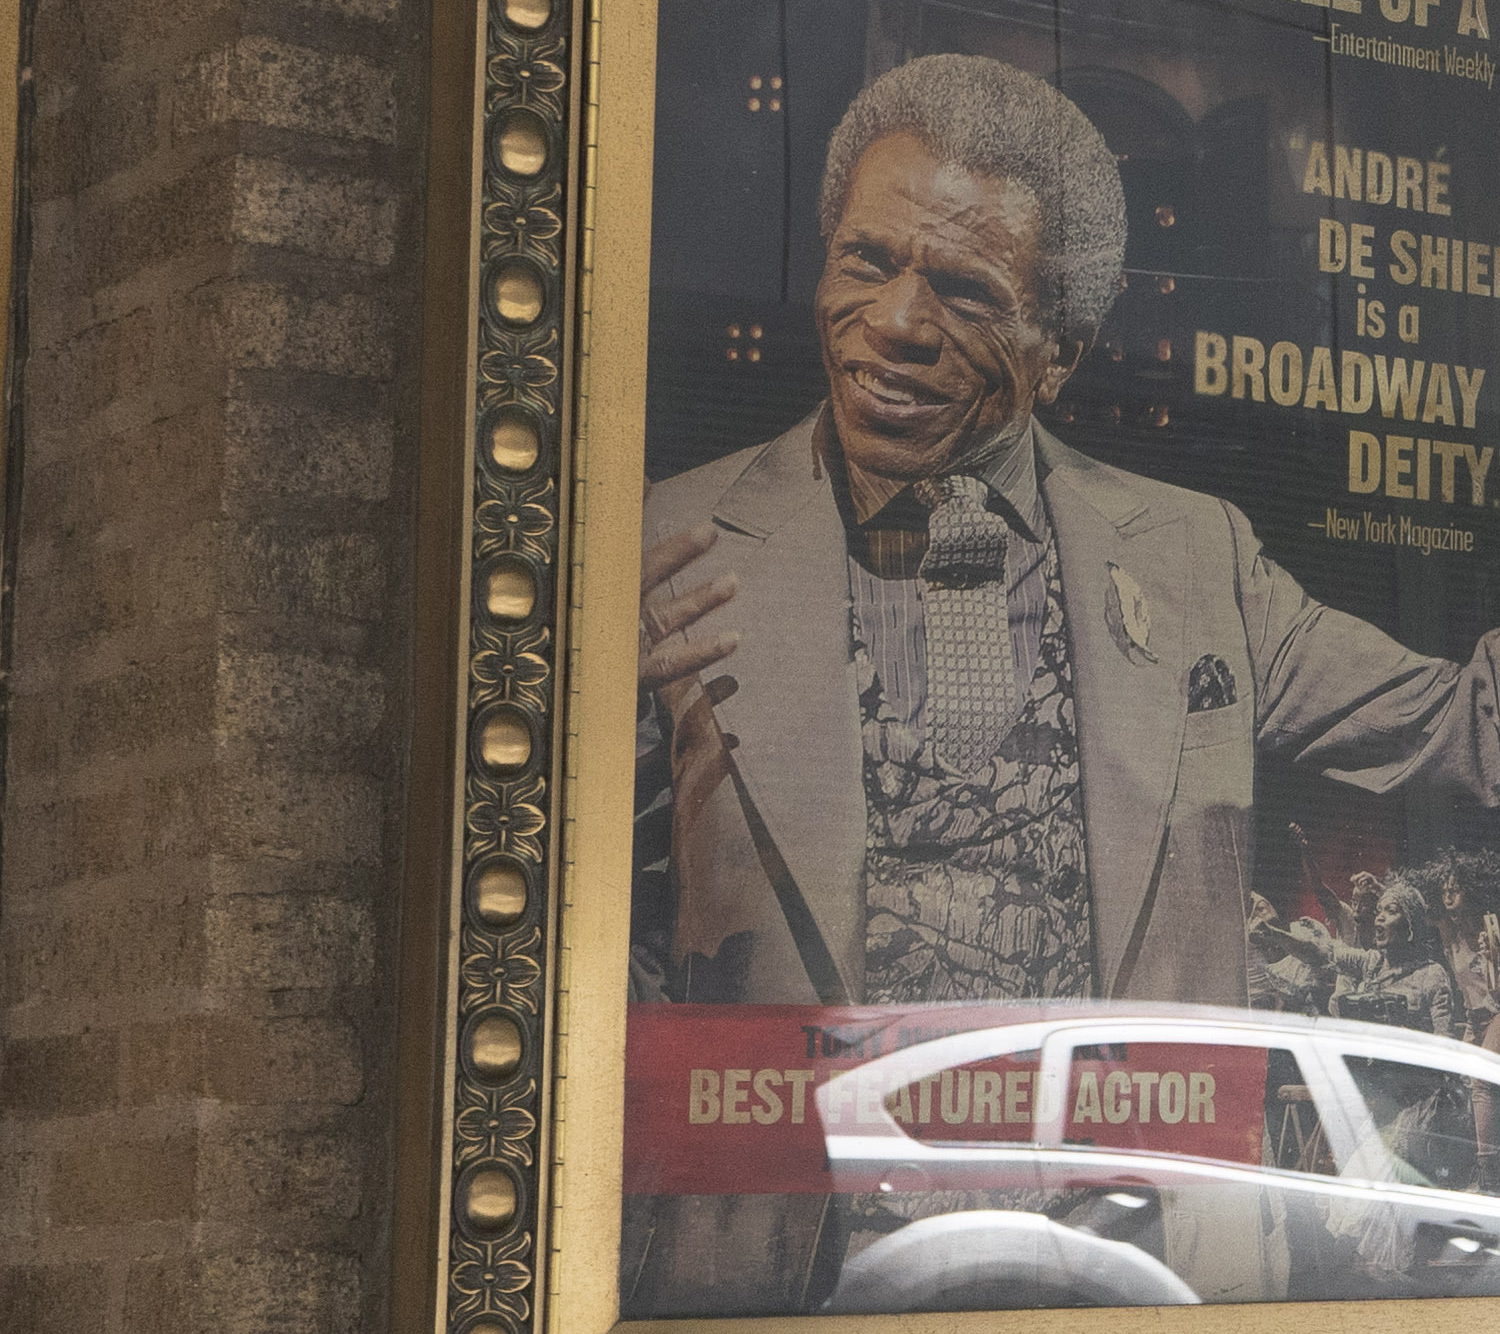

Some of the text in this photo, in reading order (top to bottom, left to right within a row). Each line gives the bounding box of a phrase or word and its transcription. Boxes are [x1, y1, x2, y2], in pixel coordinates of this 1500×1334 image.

[1443, 47, 1496, 90] Weekly
[1319, 218, 1375, 279] DE
[1357, 283, 1420, 344] is a
[1195, 331, 1487, 429] BROADWAY
[1363, 511, 1397, 545] York
[1399, 517, 1474, 556] Magazine
[689, 1068, 1217, 1125] BEST FEATURED ACTOR
